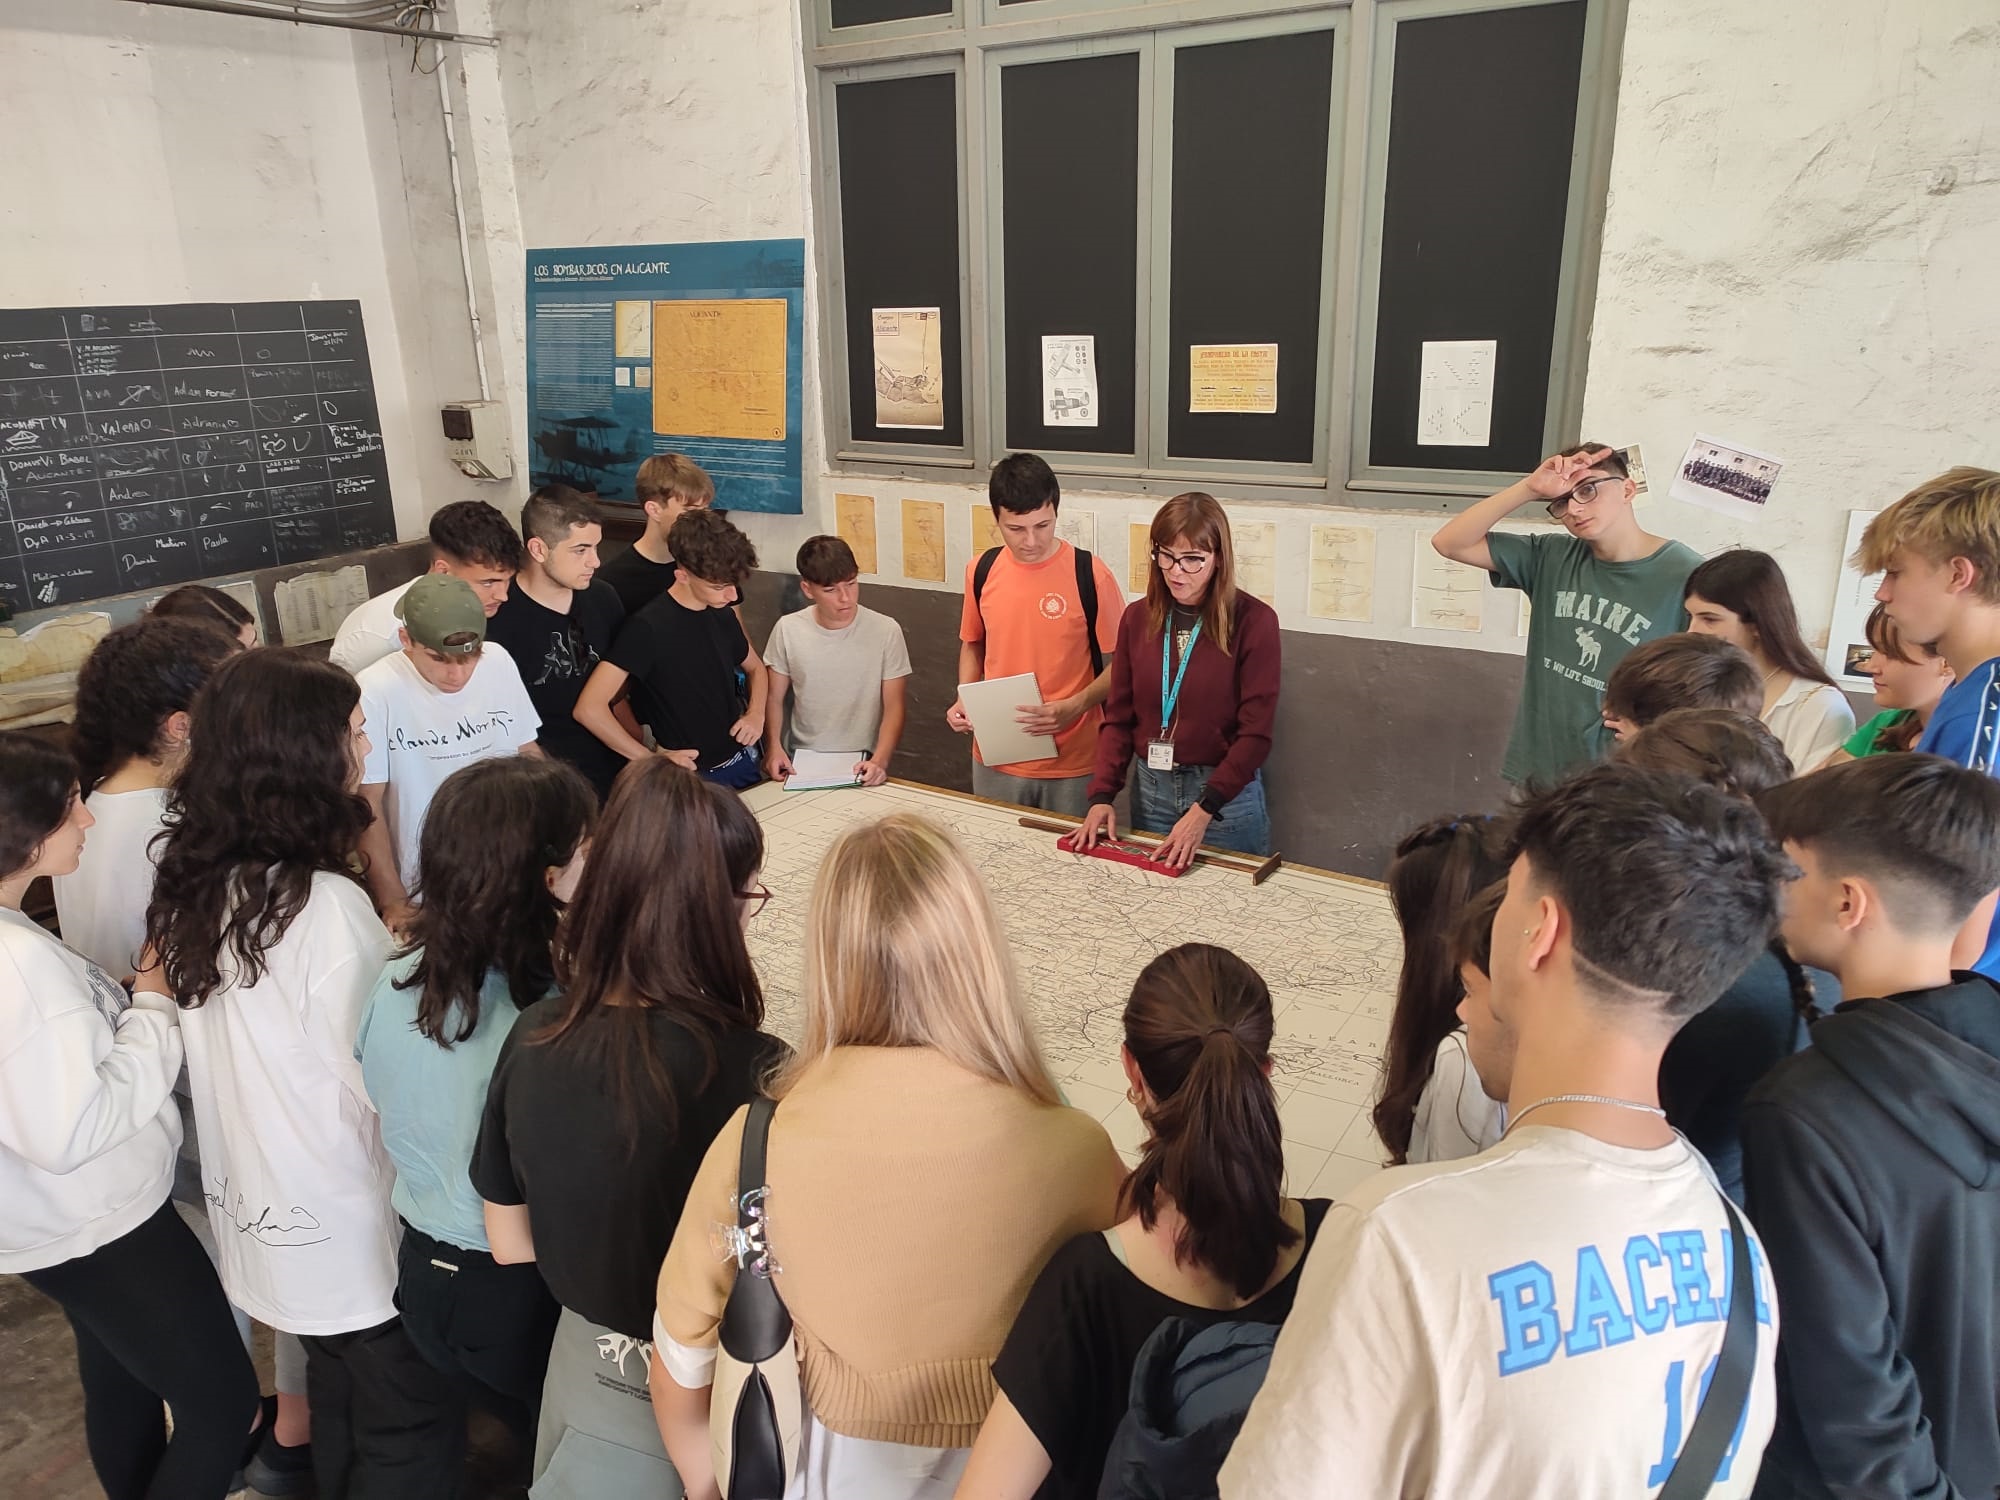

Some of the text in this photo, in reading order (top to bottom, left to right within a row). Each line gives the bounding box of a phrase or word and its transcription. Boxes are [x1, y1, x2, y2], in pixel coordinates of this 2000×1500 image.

[534, 262, 671, 276] LOS BOMBARDEOS EN ALICANTE
[1554, 590, 1653, 647] MAINE
